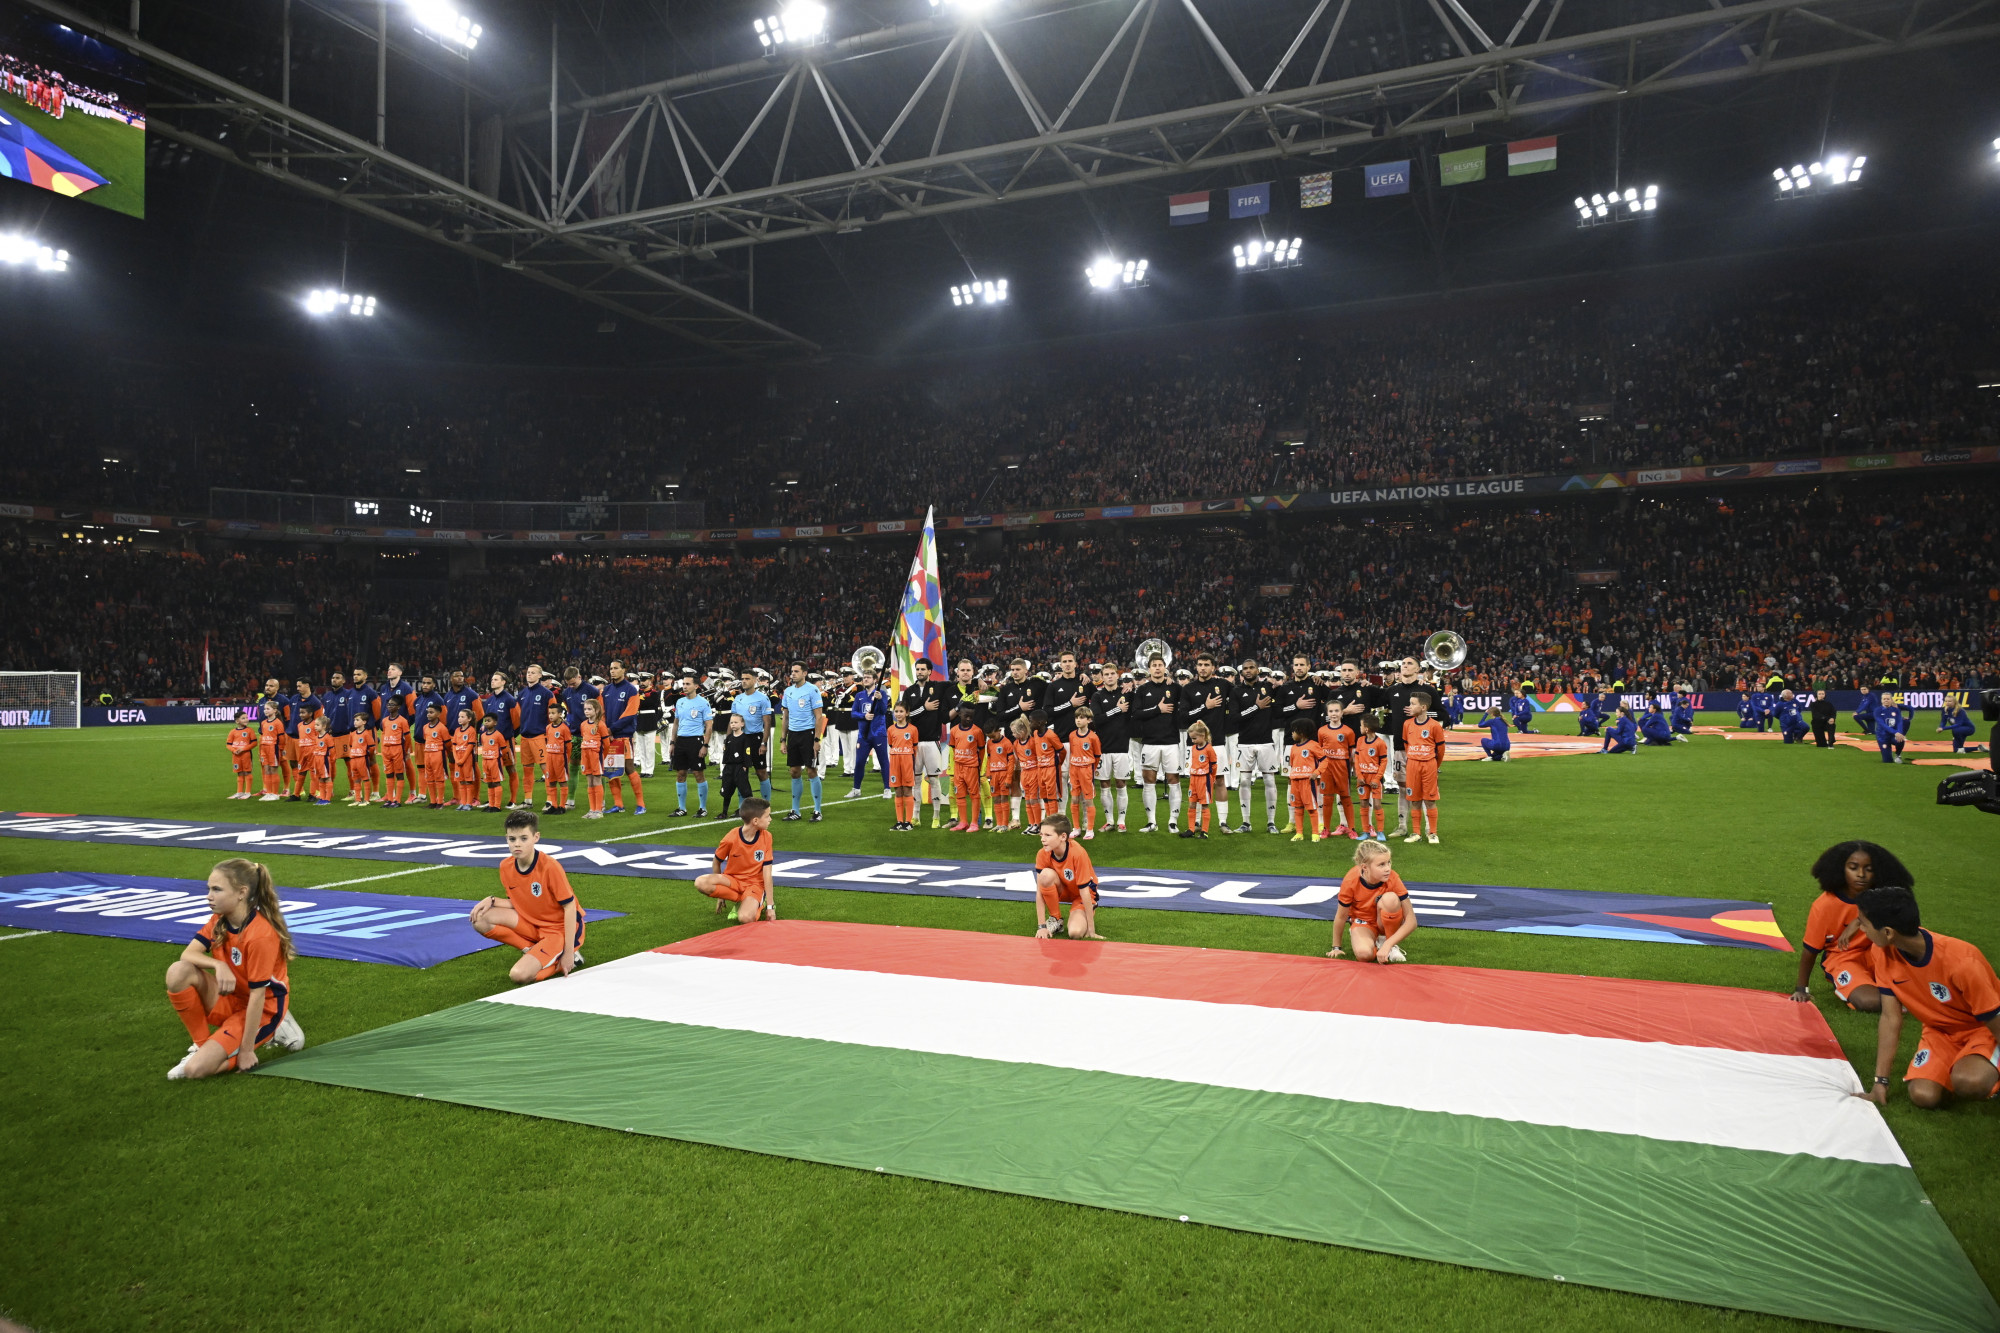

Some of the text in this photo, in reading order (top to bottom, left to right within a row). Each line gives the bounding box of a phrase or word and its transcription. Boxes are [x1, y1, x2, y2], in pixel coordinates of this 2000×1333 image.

[1453, 160, 1483, 171] RESPECT
[1371, 173, 1403, 186] UEFA
[1238, 195, 1261, 207] FIFA
[1868, 458, 1887, 466] kpn
[1640, 473, 1662, 482] ING
[1330, 480, 1524, 504] UEFA NATIONS LEAGUE
[0, 506, 17, 514] NG
[1062, 511, 1084, 519] bitvavo
[1152, 506, 1169, 514] ING
[115, 515, 135, 523] ING
[879, 523, 893, 531] ING
[1620, 694, 1672, 710] WELM
[107, 709, 147, 723] UEFA
[178, 829, 728, 870] NATIONS
[772, 859, 1477, 917] LEAGUE
